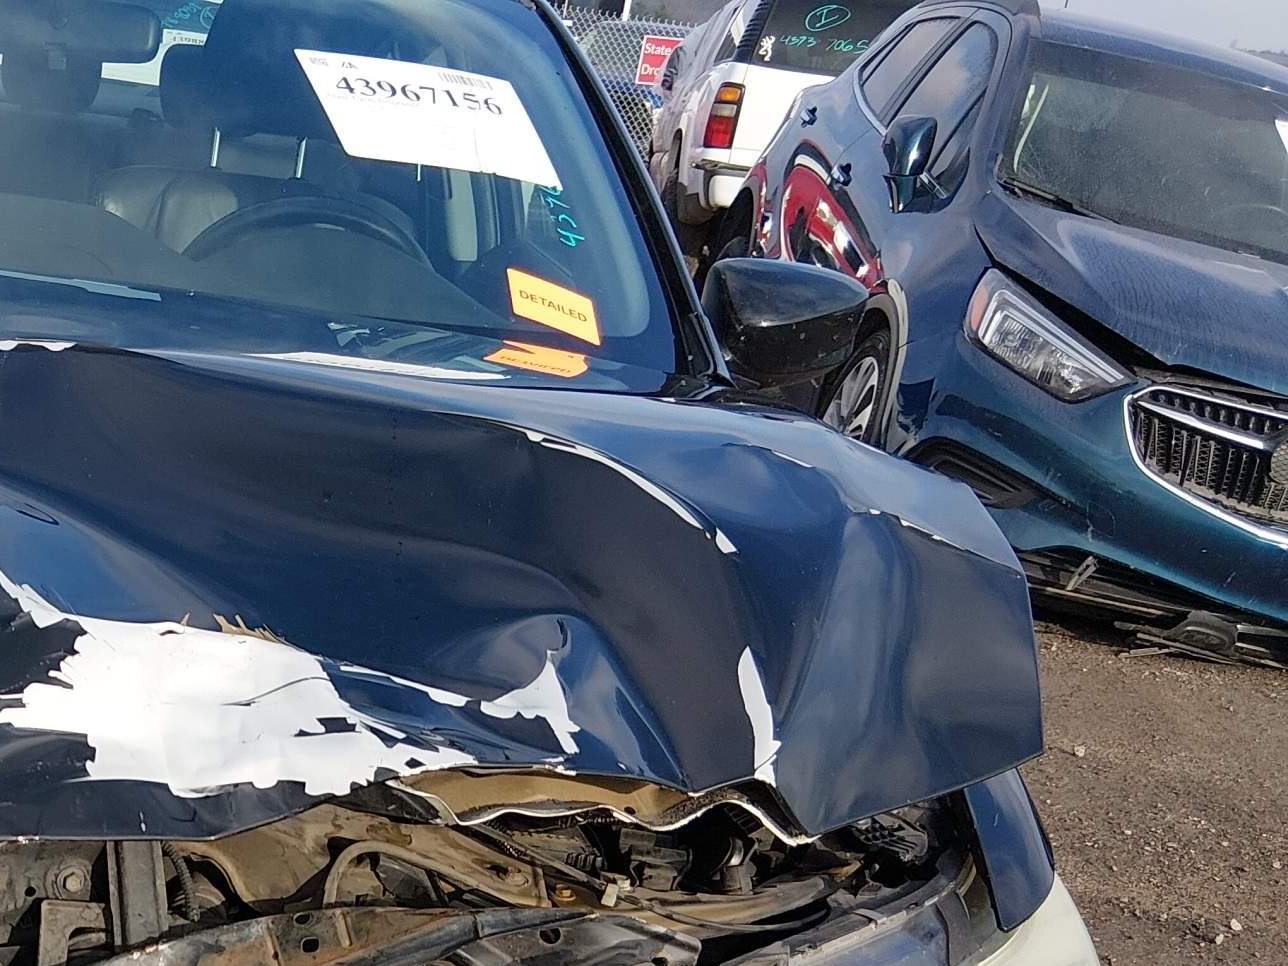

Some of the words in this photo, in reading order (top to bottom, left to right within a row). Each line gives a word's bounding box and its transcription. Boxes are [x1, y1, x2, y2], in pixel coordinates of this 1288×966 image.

[644, 43, 672, 55] State
[335, 76, 504, 116] 43967156
[518, 289, 588, 323] DETAILED
